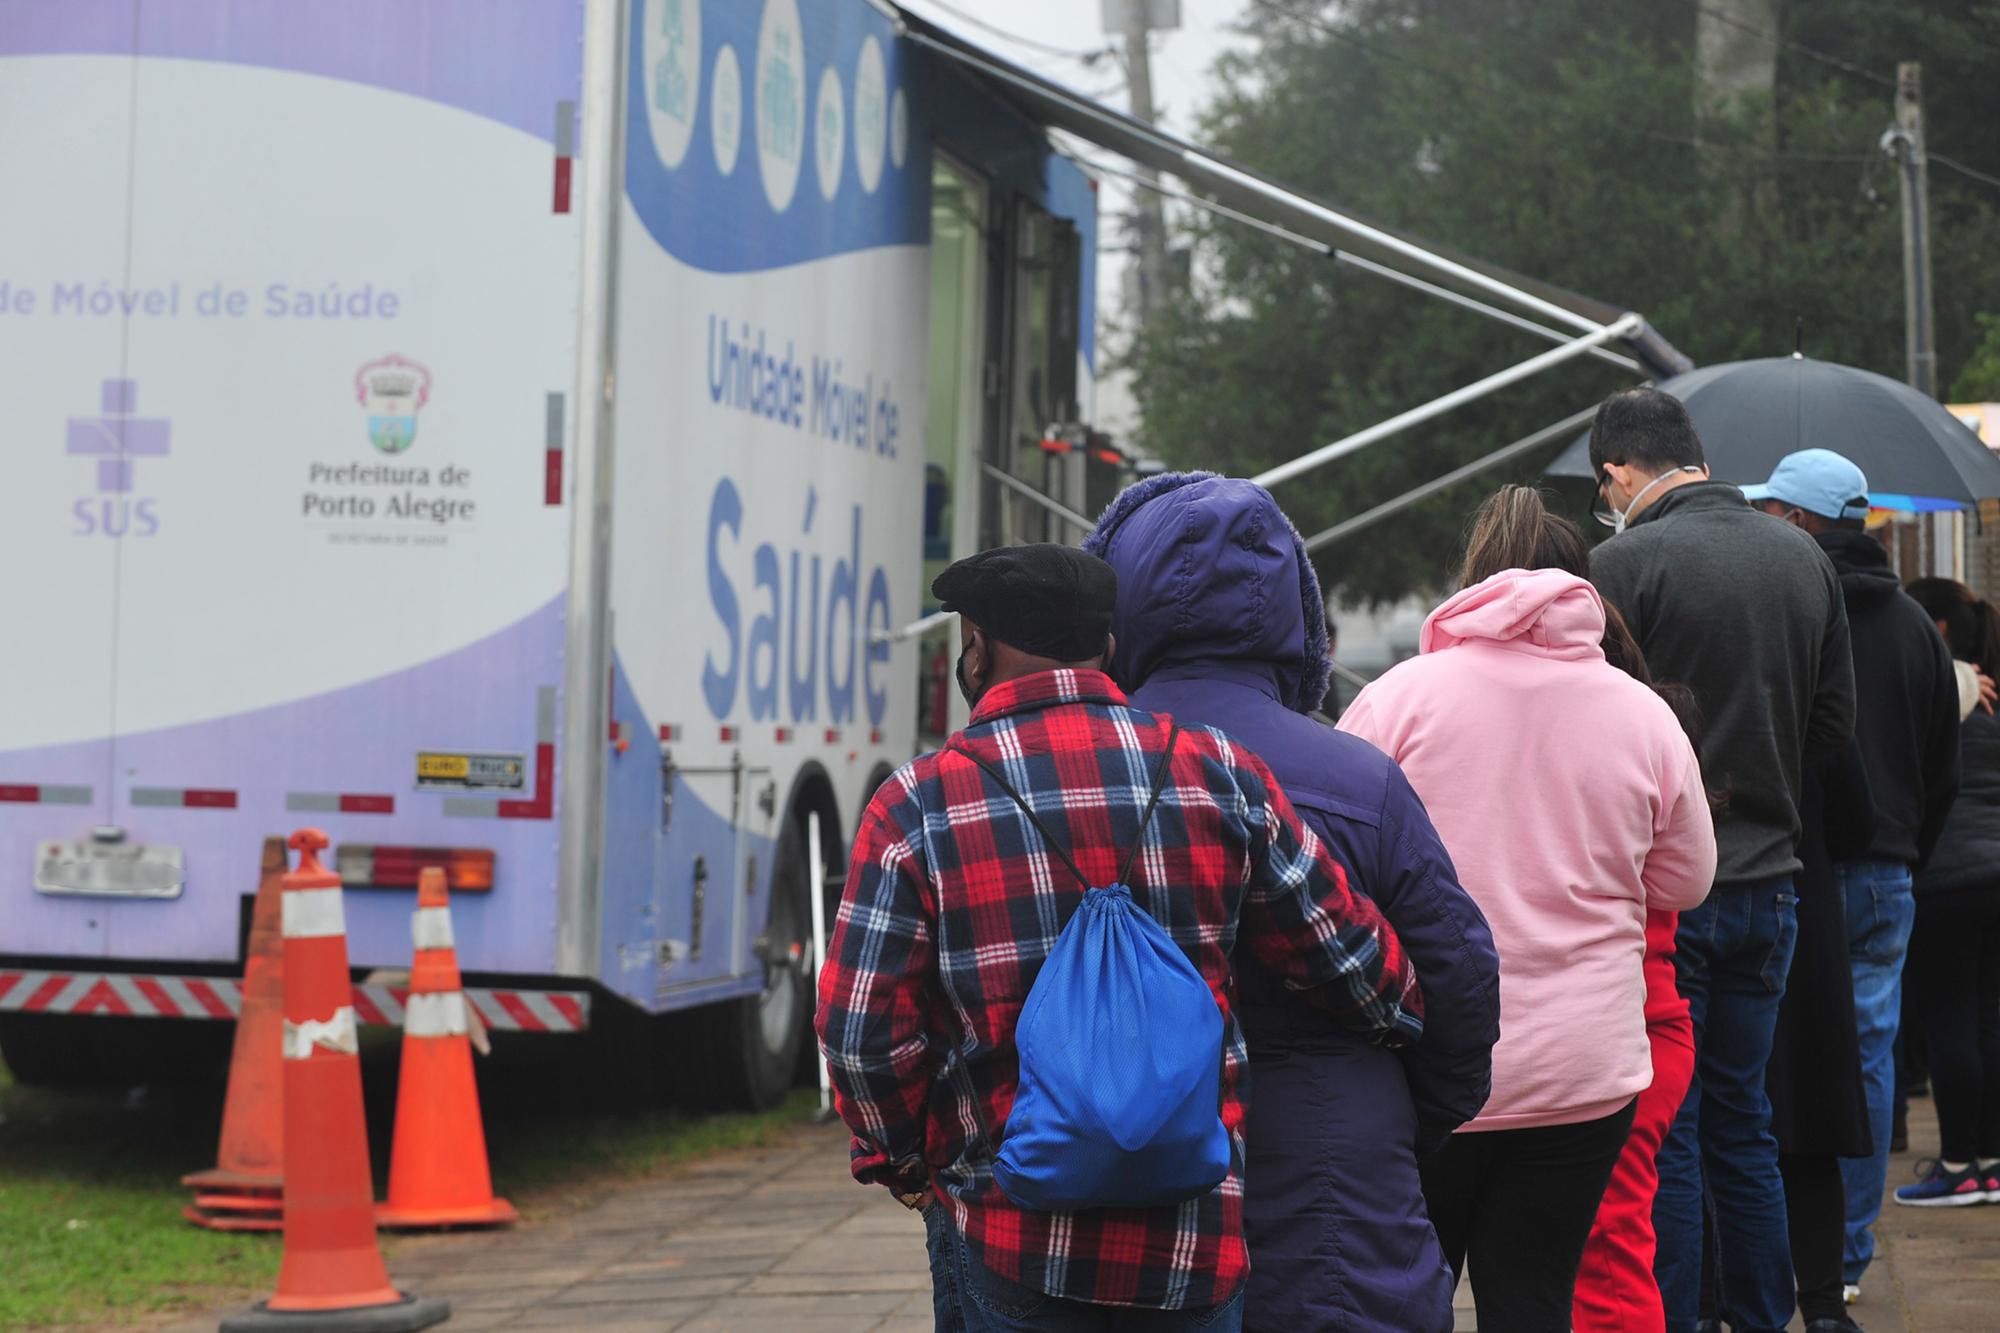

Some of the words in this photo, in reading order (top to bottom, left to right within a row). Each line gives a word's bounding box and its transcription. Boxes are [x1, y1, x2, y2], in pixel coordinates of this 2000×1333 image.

[51, 277, 180, 317] Móvel
[194, 279, 249, 318] de
[264, 279, 401, 319] Saúde
[707, 313, 804, 428] Unidade
[812, 354, 872, 454] Móvel
[874, 380, 899, 460] de
[309, 461, 430, 487] Prefeitura
[439, 463, 471, 487] de
[72, 496, 160, 539] SUS
[302, 491, 376, 518] Porto
[386, 490, 476, 525] Alegre
[702, 475, 892, 727] Saúde
